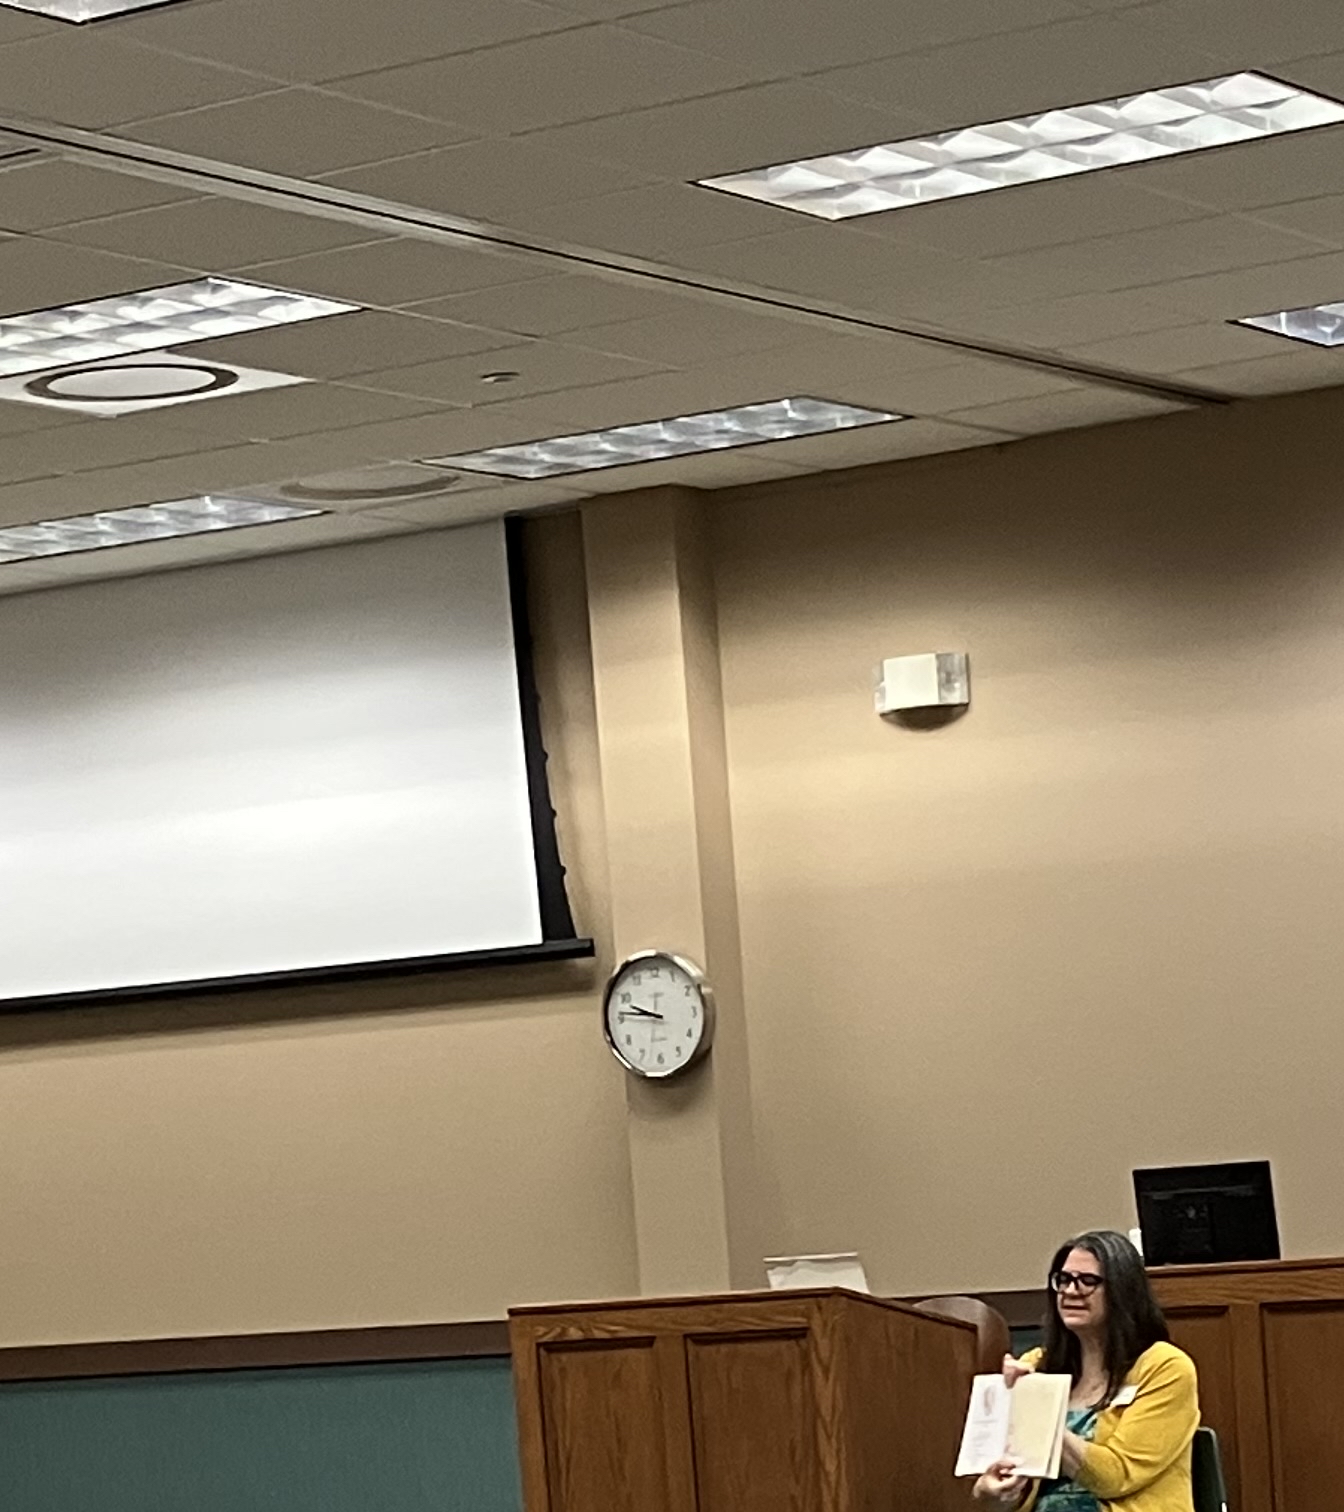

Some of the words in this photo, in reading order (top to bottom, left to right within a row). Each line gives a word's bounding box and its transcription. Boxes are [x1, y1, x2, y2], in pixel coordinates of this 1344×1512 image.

[684, 984, 692, 997] 2
[691, 1006, 698, 1019] 3
[617, 1014, 625, 1025] 9
[686, 1027, 693, 1039] 4
[625, 1034, 633, 1046] 8
[638, 1048, 646, 1062] 7
[675, 1046, 682, 1058] 5
[656, 1053, 665, 1065] 6
